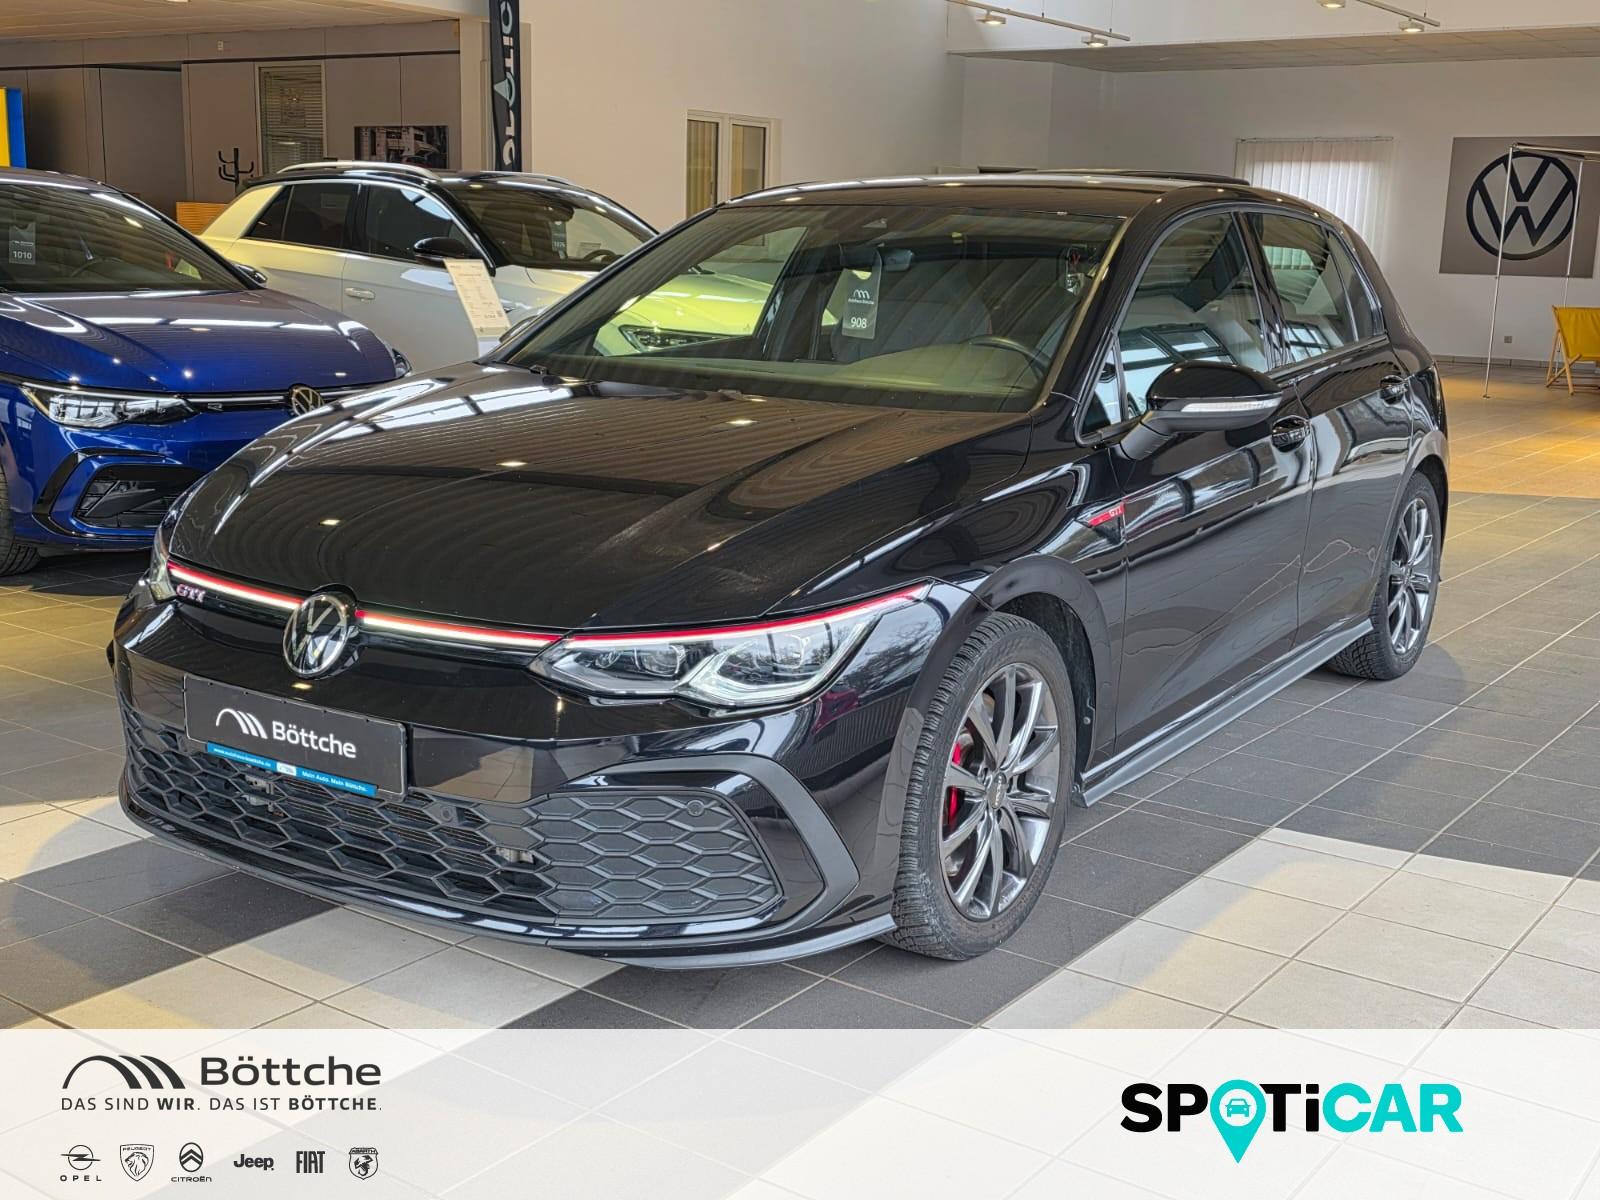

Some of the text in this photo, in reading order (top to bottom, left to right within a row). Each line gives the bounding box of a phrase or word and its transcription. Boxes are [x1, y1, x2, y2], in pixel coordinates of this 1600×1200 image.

[12, 250, 32, 260] 1010
[850, 316, 867, 329] 908
[176, 583, 206, 602] GTI
[272, 720, 357, 759] Böttche
